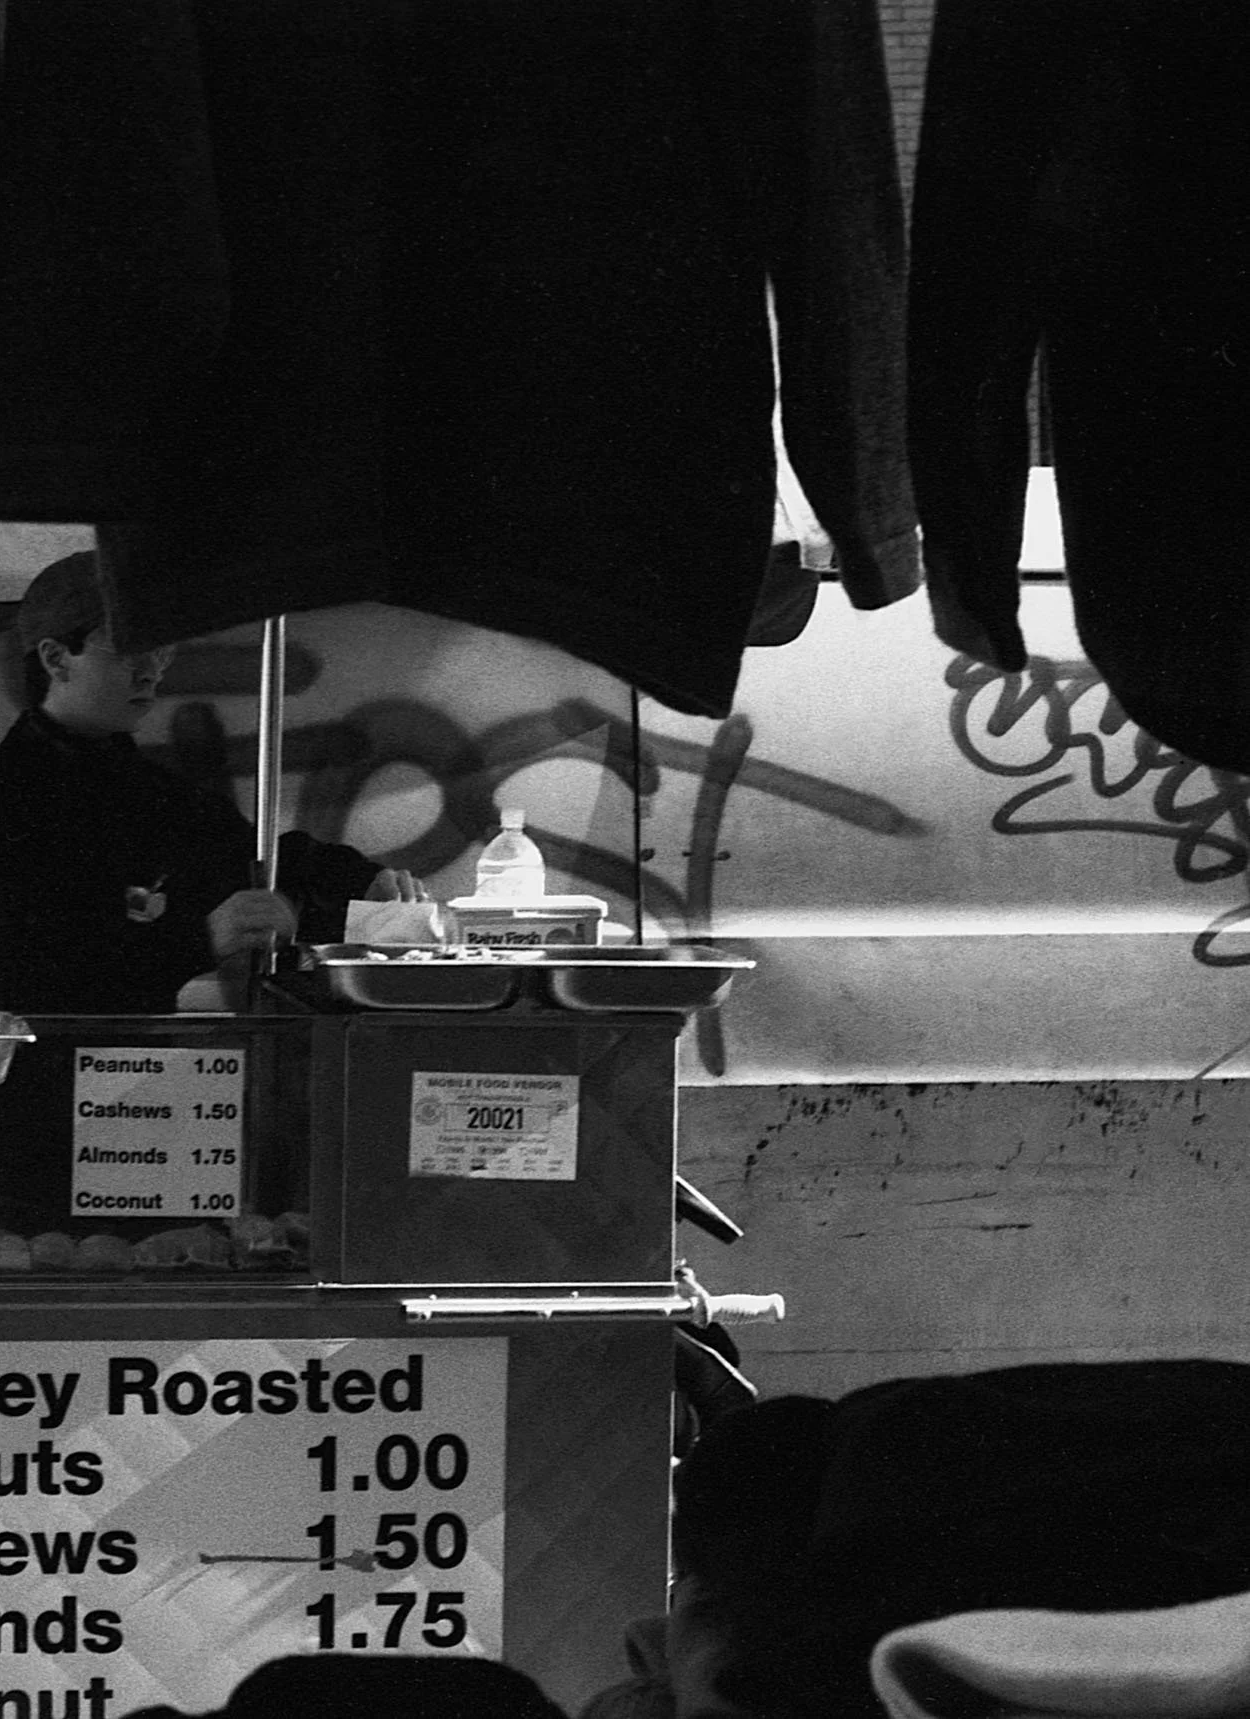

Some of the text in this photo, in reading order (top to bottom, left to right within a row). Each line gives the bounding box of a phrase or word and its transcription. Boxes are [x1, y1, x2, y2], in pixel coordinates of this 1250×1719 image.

[79, 1054, 239, 1075] Peanuts 1.00
[427, 1078, 562, 1090] MOBILE FOOD VENDOR
[78, 1100, 238, 1120] Cashews 1.50
[467, 1106, 524, 1130] 20021
[77, 1146, 237, 1166] Almonds 1.75
[75, 1191, 235, 1211] Coconut 1.00
[108, 1354, 424, 1416] Roasted
[307, 1433, 469, 1493] 1.00
[306, 1511, 468, 1573] 150
[306, 1591, 467, 1650] 1.75
